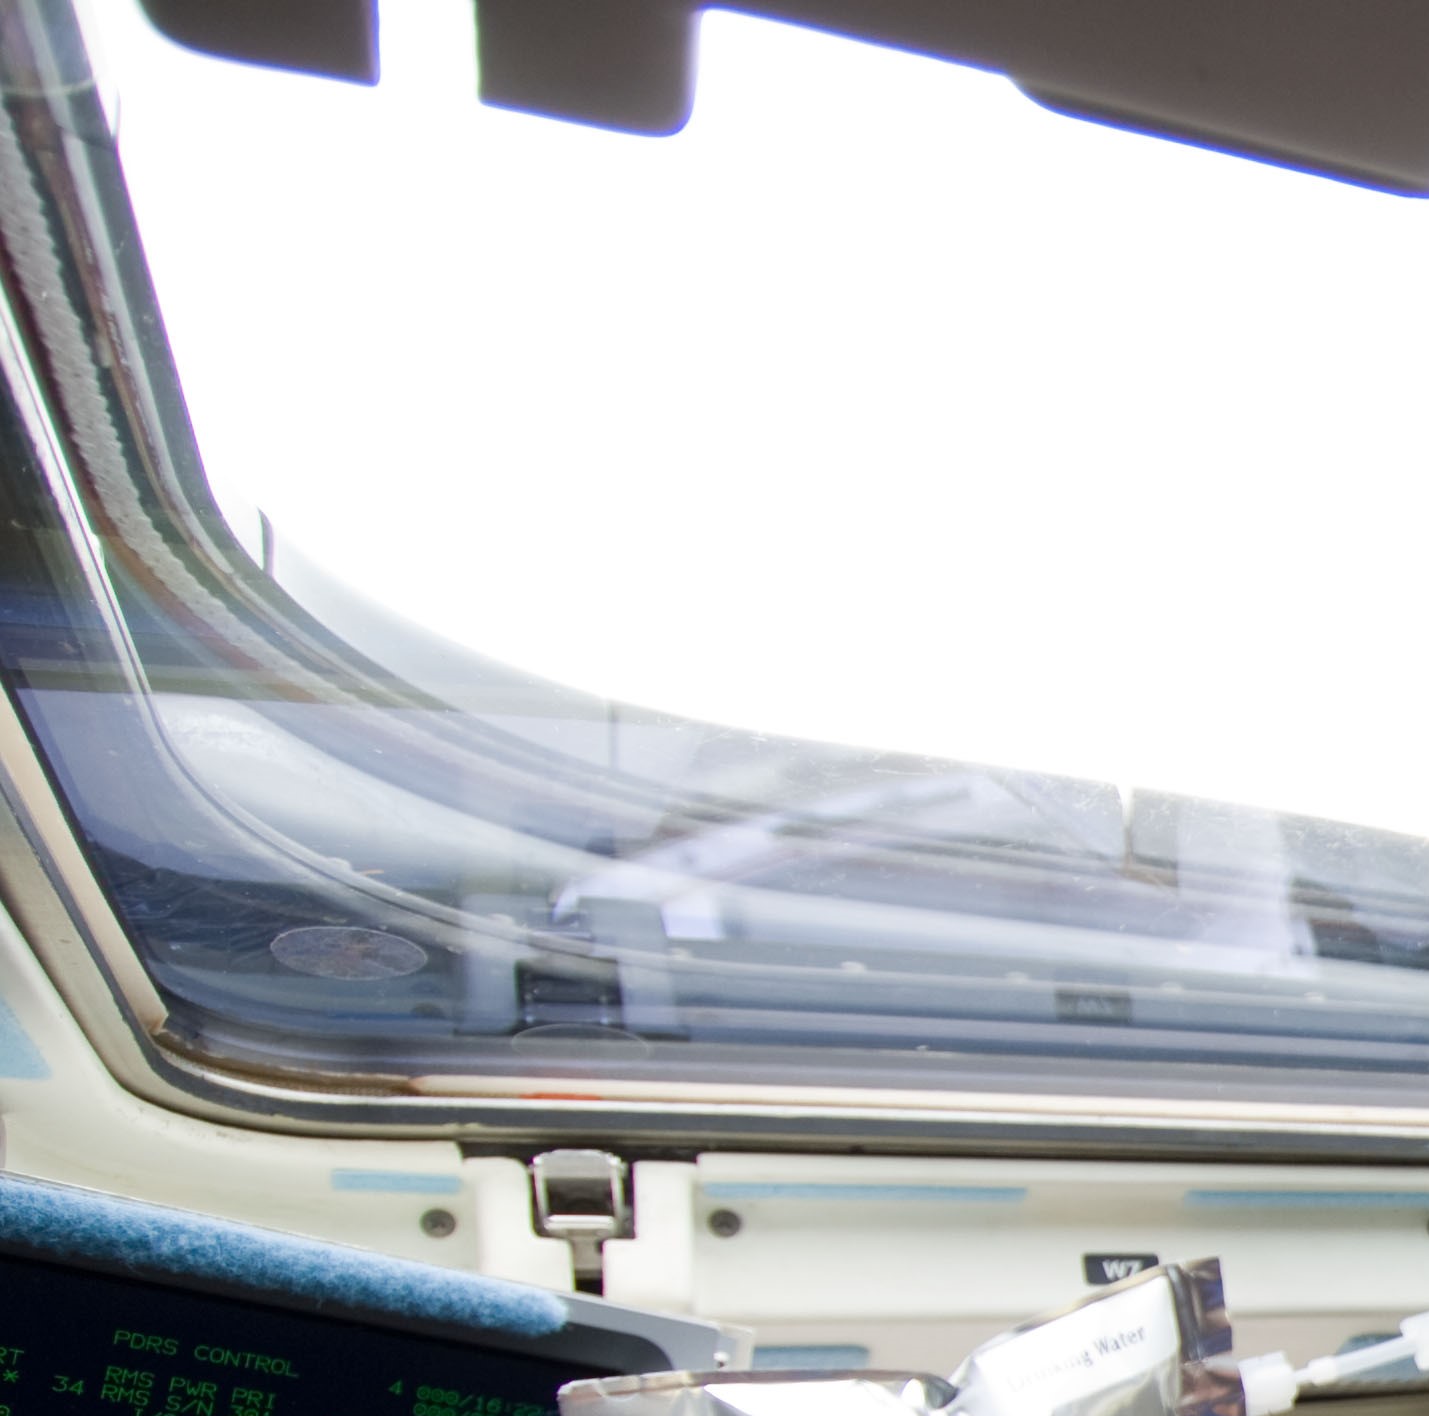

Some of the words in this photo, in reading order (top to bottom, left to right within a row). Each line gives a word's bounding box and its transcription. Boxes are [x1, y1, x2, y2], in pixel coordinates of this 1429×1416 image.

[113, 1330, 179, 1356] PDRS
[194, 1345, 299, 1378] CONTROL
[1094, 1326, 1146, 1354] Water
[52, 1374, 85, 1396] 34
[104, 1365, 155, 1389] RMS
[168, 1376, 218, 1400] PWR
[231, 1387, 276, 1410] PRI
[99, 1384, 150, 1407] RMS
[165, 1395, 214, 1416] S/N
